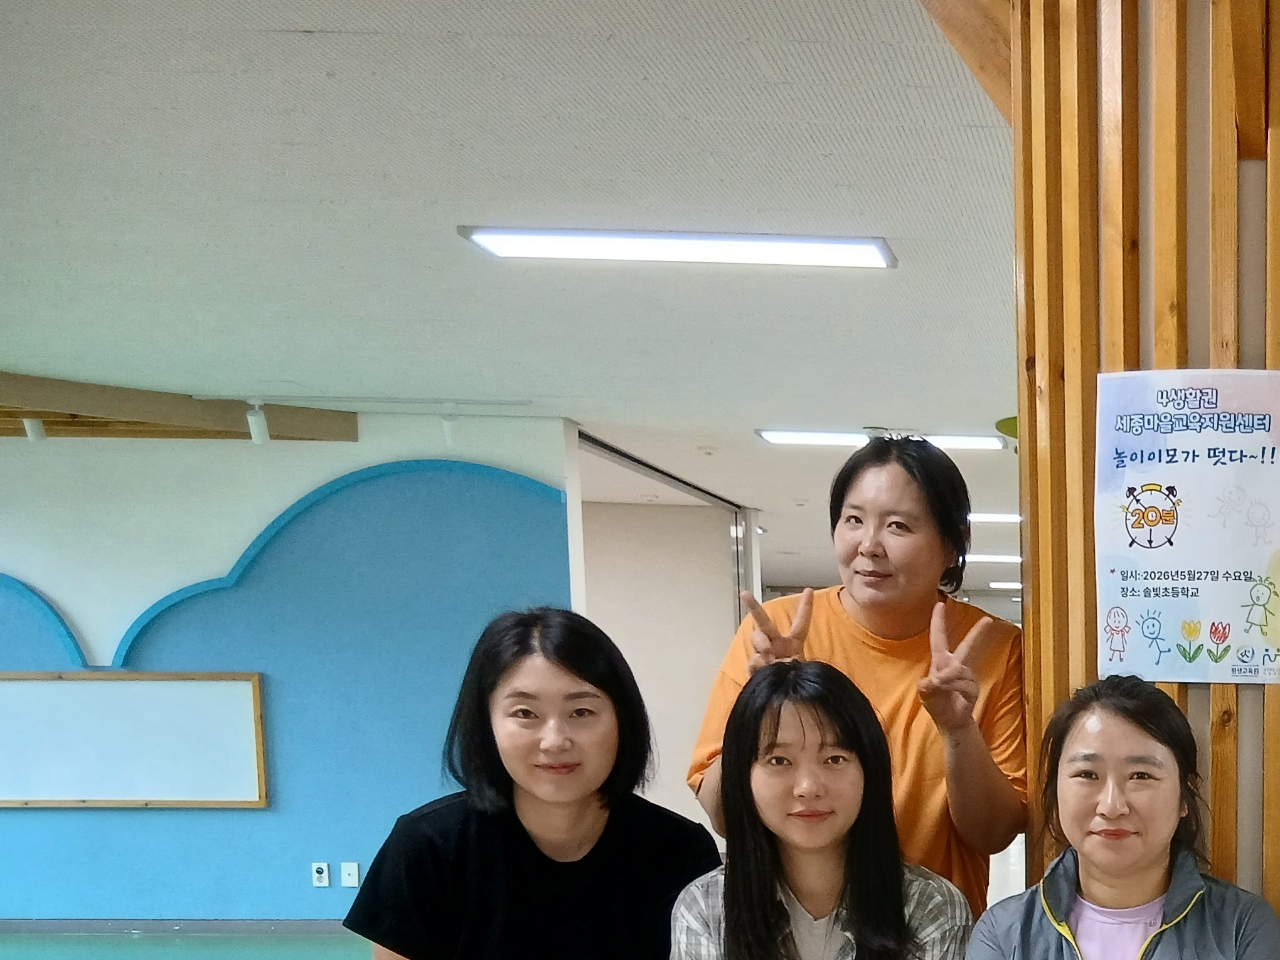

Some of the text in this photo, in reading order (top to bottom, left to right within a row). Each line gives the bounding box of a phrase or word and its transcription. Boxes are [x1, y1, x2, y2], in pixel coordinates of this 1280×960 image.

[1157, 387, 1219, 409] 4생활권
[1115, 412, 1271, 435] 세종마을교육지원센터
[1113, 447, 1200, 469] 놀이이모가
[1131, 505, 1175, 529] 20분
[1143, 569, 1219, 582] 2026년5월27일
[1222, 569, 1253, 582] 수요일
[1120, 586, 1200, 598] 장소: 솔빛초등학교
